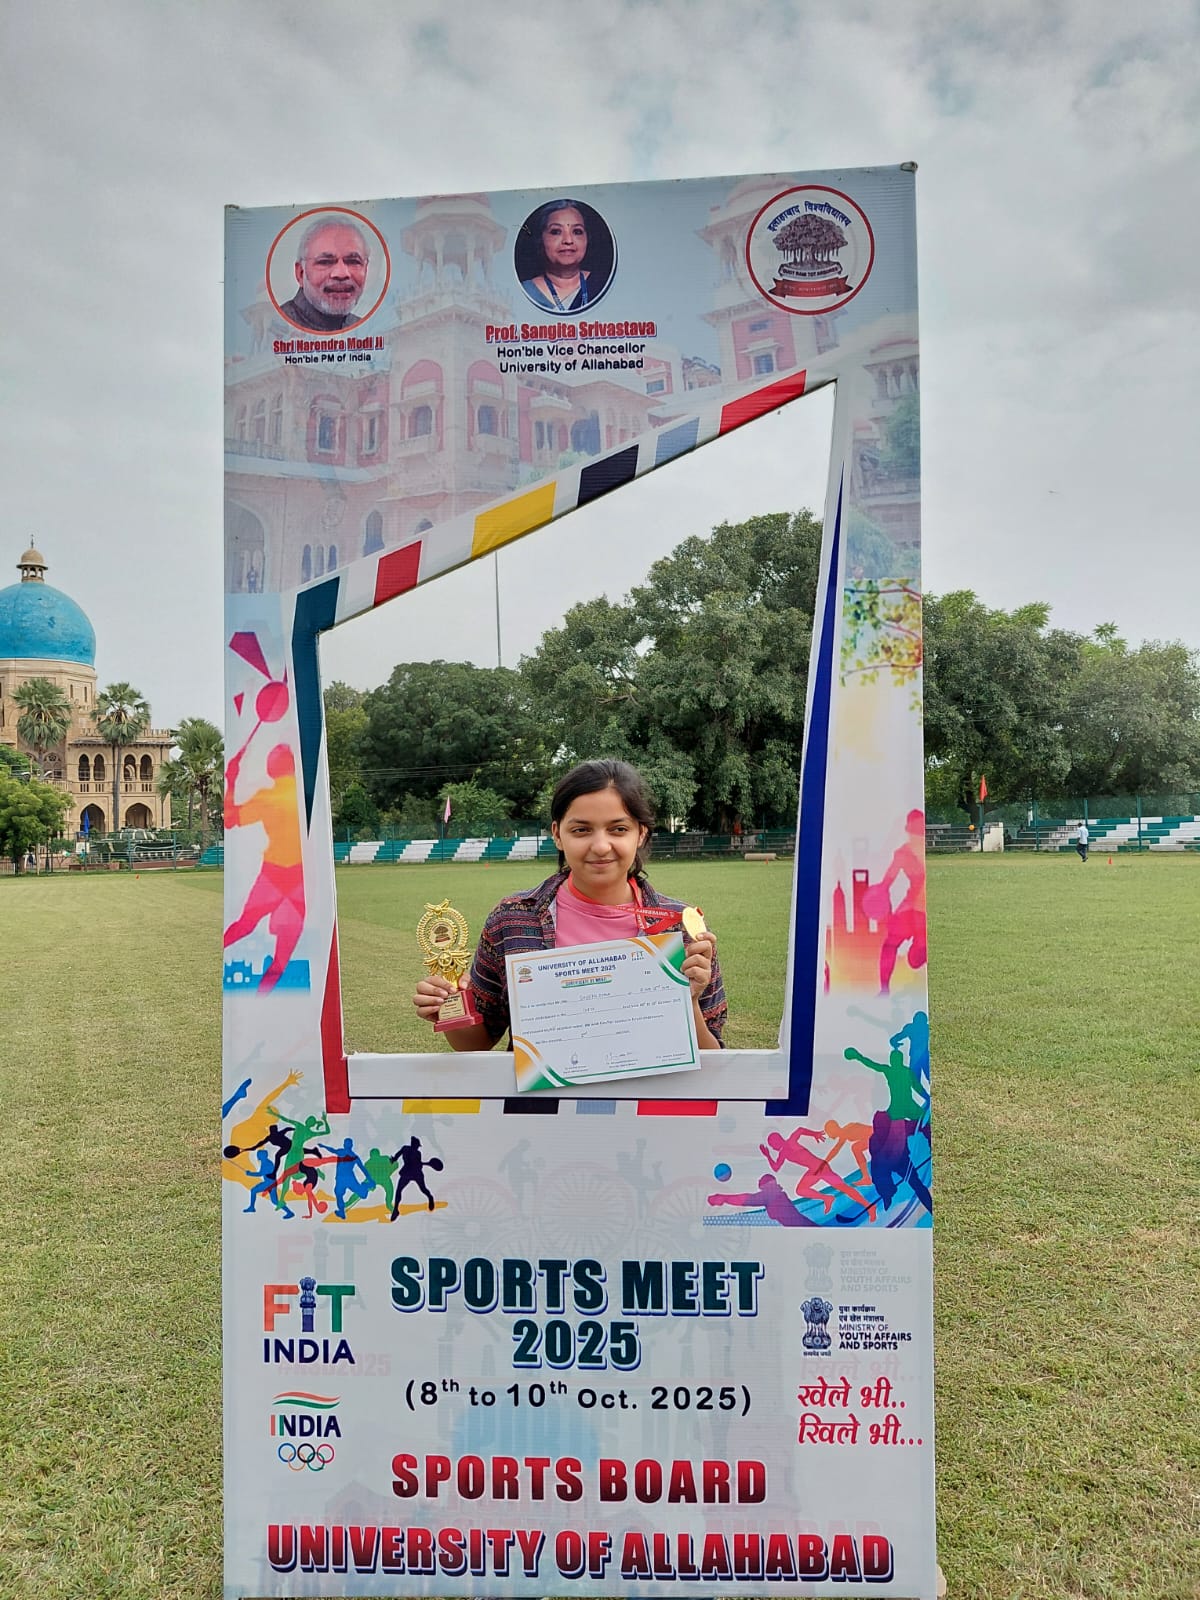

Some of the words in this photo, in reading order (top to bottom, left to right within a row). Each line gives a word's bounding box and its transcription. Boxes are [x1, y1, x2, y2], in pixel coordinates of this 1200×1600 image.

[486, 324, 520, 343] Prof.
[521, 322, 577, 342] Sangita
[579, 320, 657, 339] Srivastava
[273, 340, 295, 353] Shri
[296, 338, 346, 353] Narendra
[347, 337, 373, 351] Modi
[374, 336, 384, 350] Ji
[497, 345, 543, 358] Hon'ble
[547, 344, 574, 356] Vice
[577, 342, 645, 355] Chancellor
[285, 355, 319, 364] Hon'ble
[321, 354, 335, 362] PM
[336, 354, 347, 362] of
[349, 353, 372, 362] India
[500, 360, 561, 374] University
[564, 359, 577, 371] of
[581, 358, 644, 370] Allahabad
[538, 961, 577, 971] UNIVERSITY
[578, 959, 587, 967] OF
[588, 954, 627, 965] ALLAHABAD
[554, 969, 581, 978] SPORTS
[601, 964, 616, 972] 2025
[391, 1256, 608, 1314] SPORTS
[621, 1260, 765, 1317] MEET
[839, 1305, 850, 1314] युवा
[512, 1319, 641, 1371] 2025
[839, 1332, 872, 1341] YOUTH
[874, 1332, 912, 1341] AFFAIRS
[839, 1342, 861, 1350] AND
[863, 1342, 899, 1350] SPORTS
[263, 1338, 356, 1365] INDIA
[469, 1387, 496, 1407] to
[507, 1380, 568, 1408] 10th
[578, 1388, 638, 1409] Oct.
[651, 1385, 751, 1416] 2025)
[270, 1414, 342, 1438] INDIA
[798, 1413, 861, 1445] खिले
[391, 1453, 583, 1502] SPORTS
[599, 1457, 767, 1504] BOARD
[267, 1524, 546, 1579] UNIVERSITY
[555, 1529, 612, 1580] OF
[621, 1531, 895, 1583] ALLAHABAD
